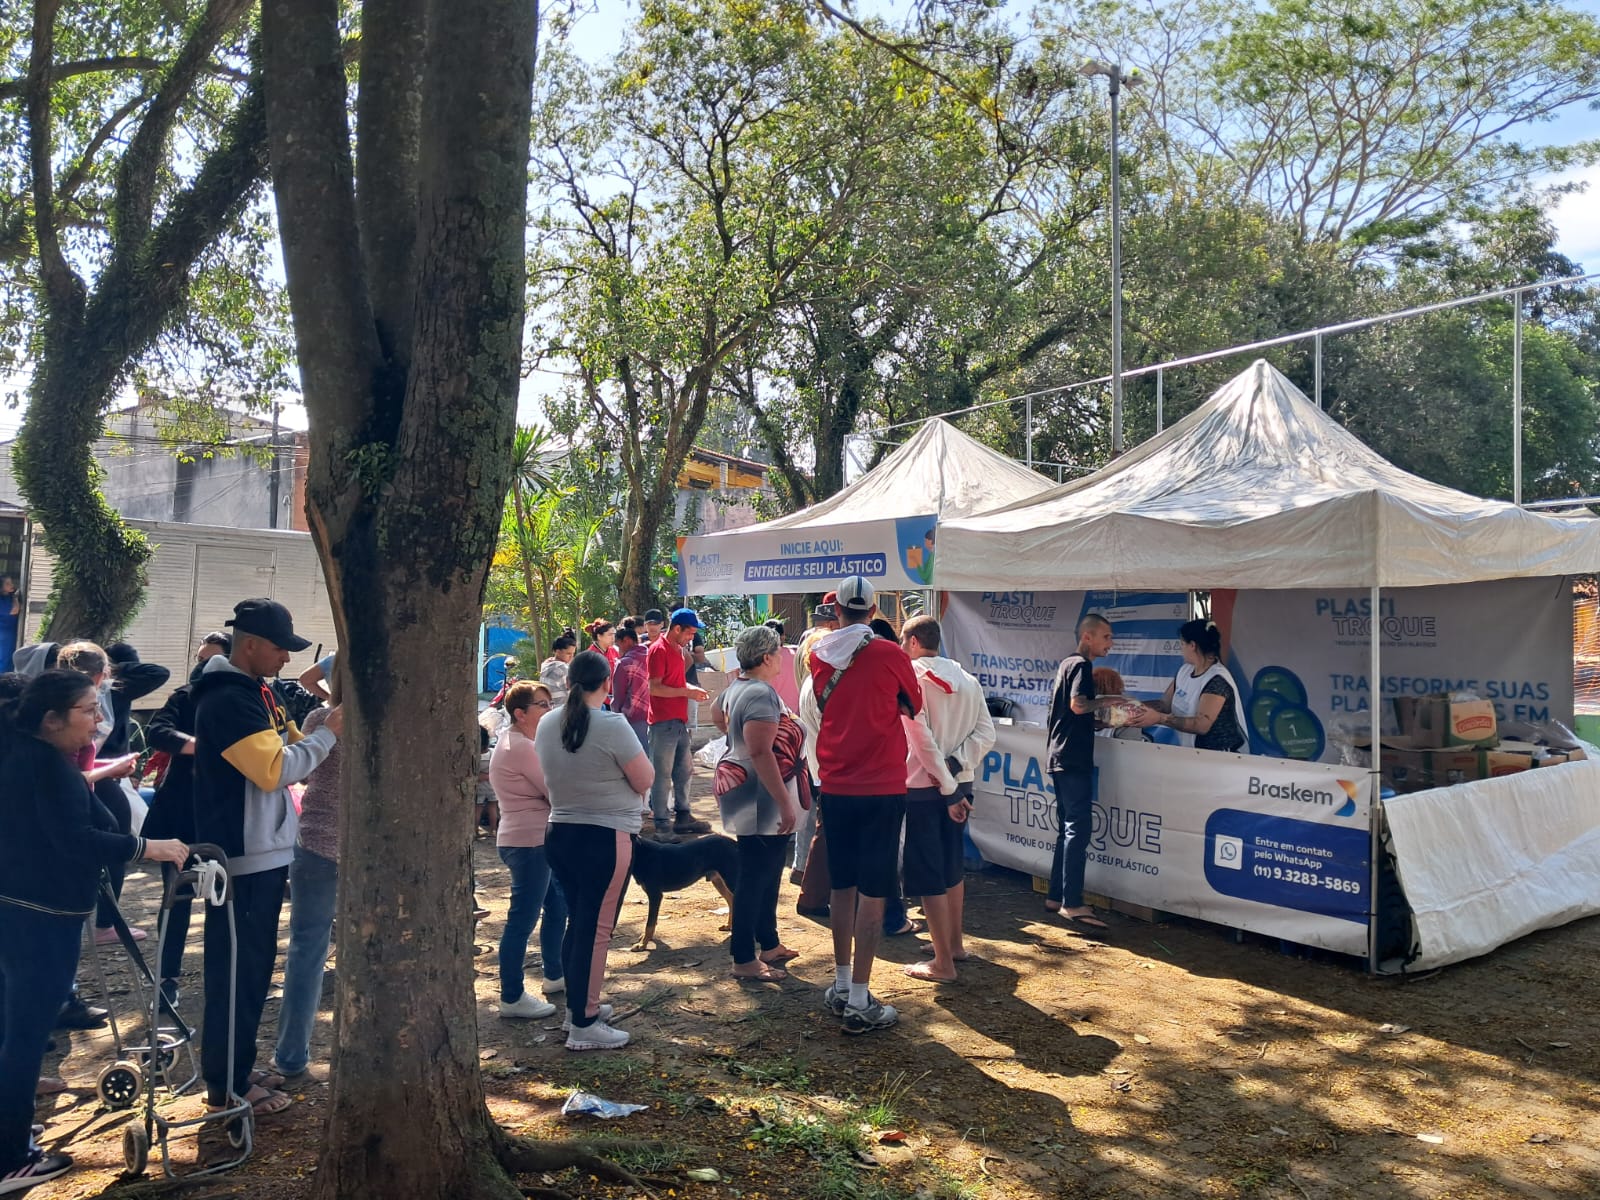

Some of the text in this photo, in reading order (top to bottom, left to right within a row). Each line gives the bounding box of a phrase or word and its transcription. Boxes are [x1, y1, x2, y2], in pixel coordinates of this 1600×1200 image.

[780, 540, 844, 555] INICIE AQUI:
[689, 552, 720, 566] PLASTI
[747, 557, 883, 578] ENTREGUE SEU PLÁSTICO
[981, 591, 1035, 605] PLASTI
[990, 604, 1057, 624] TROQUE
[971, 653, 1060, 673] TRANSFORM
[1486, 680, 1551, 701] SUAS
[1248, 776, 1333, 806] Braskem
[1006, 833, 1037, 848] TROQUE
[1037, 840, 1045, 849] O
[1096, 854, 1115, 866] SEU
[1115, 857, 1160, 876] PLÁSTICO
[1255, 836, 1333, 858] Entre em contato
[1254, 850, 1322, 870] pelo WhatsApp
[1253, 865, 1361, 895] (11) 9.3283-5869
